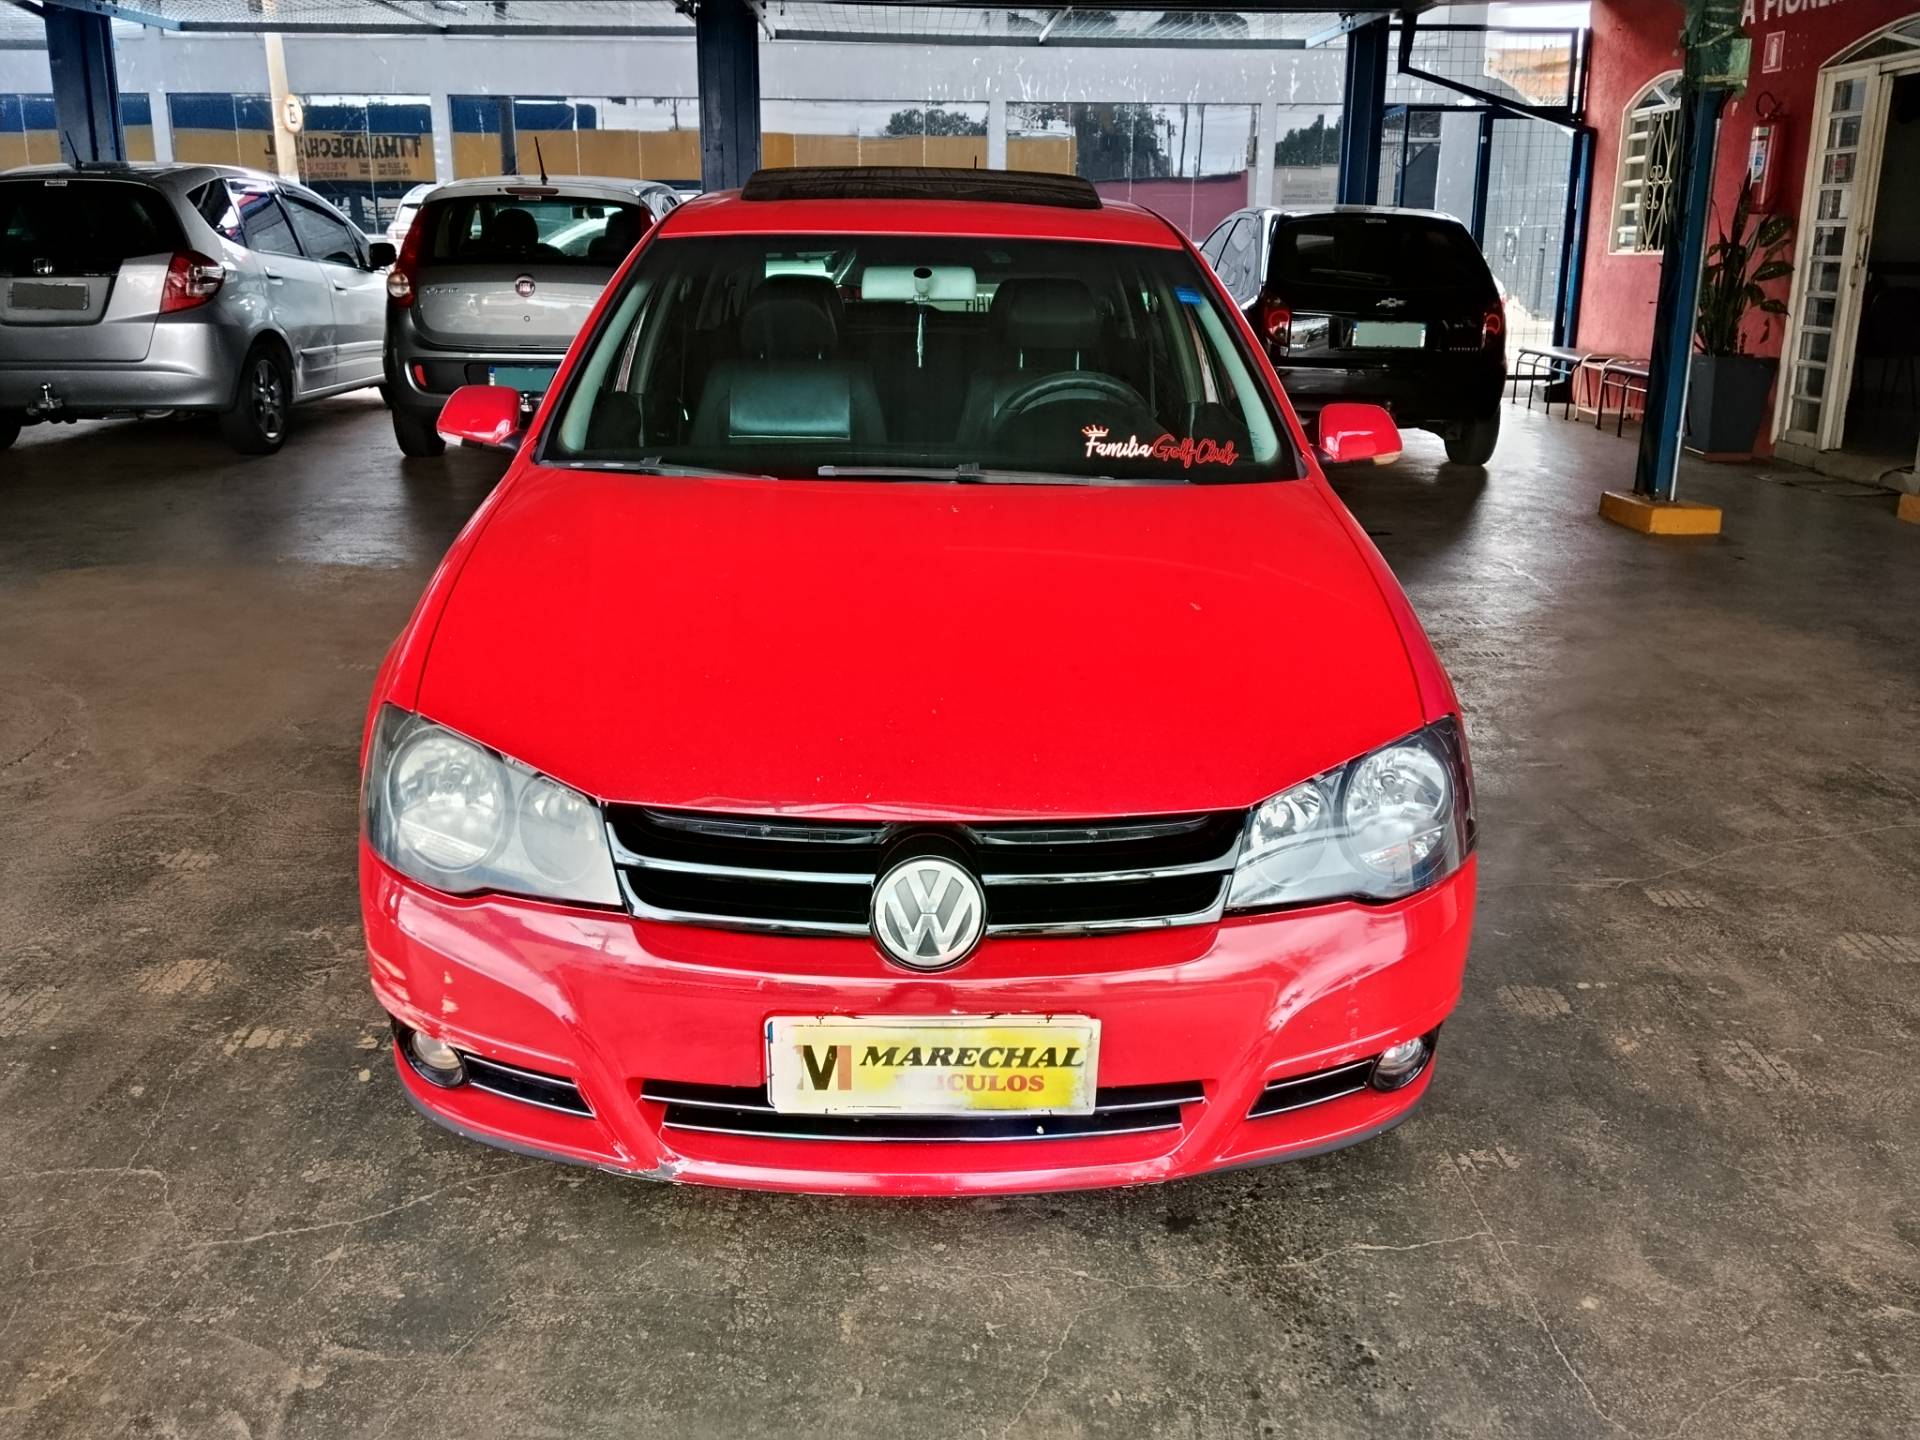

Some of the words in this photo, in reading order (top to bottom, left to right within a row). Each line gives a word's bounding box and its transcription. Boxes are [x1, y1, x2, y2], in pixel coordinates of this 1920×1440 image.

[1084, 433, 1153, 458] Familia
[1153, 433, 1196, 468] Golf
[1196, 438, 1239, 466] Club
[879, 863, 980, 964] VW
[859, 1046, 1085, 1069] MARECHAL
